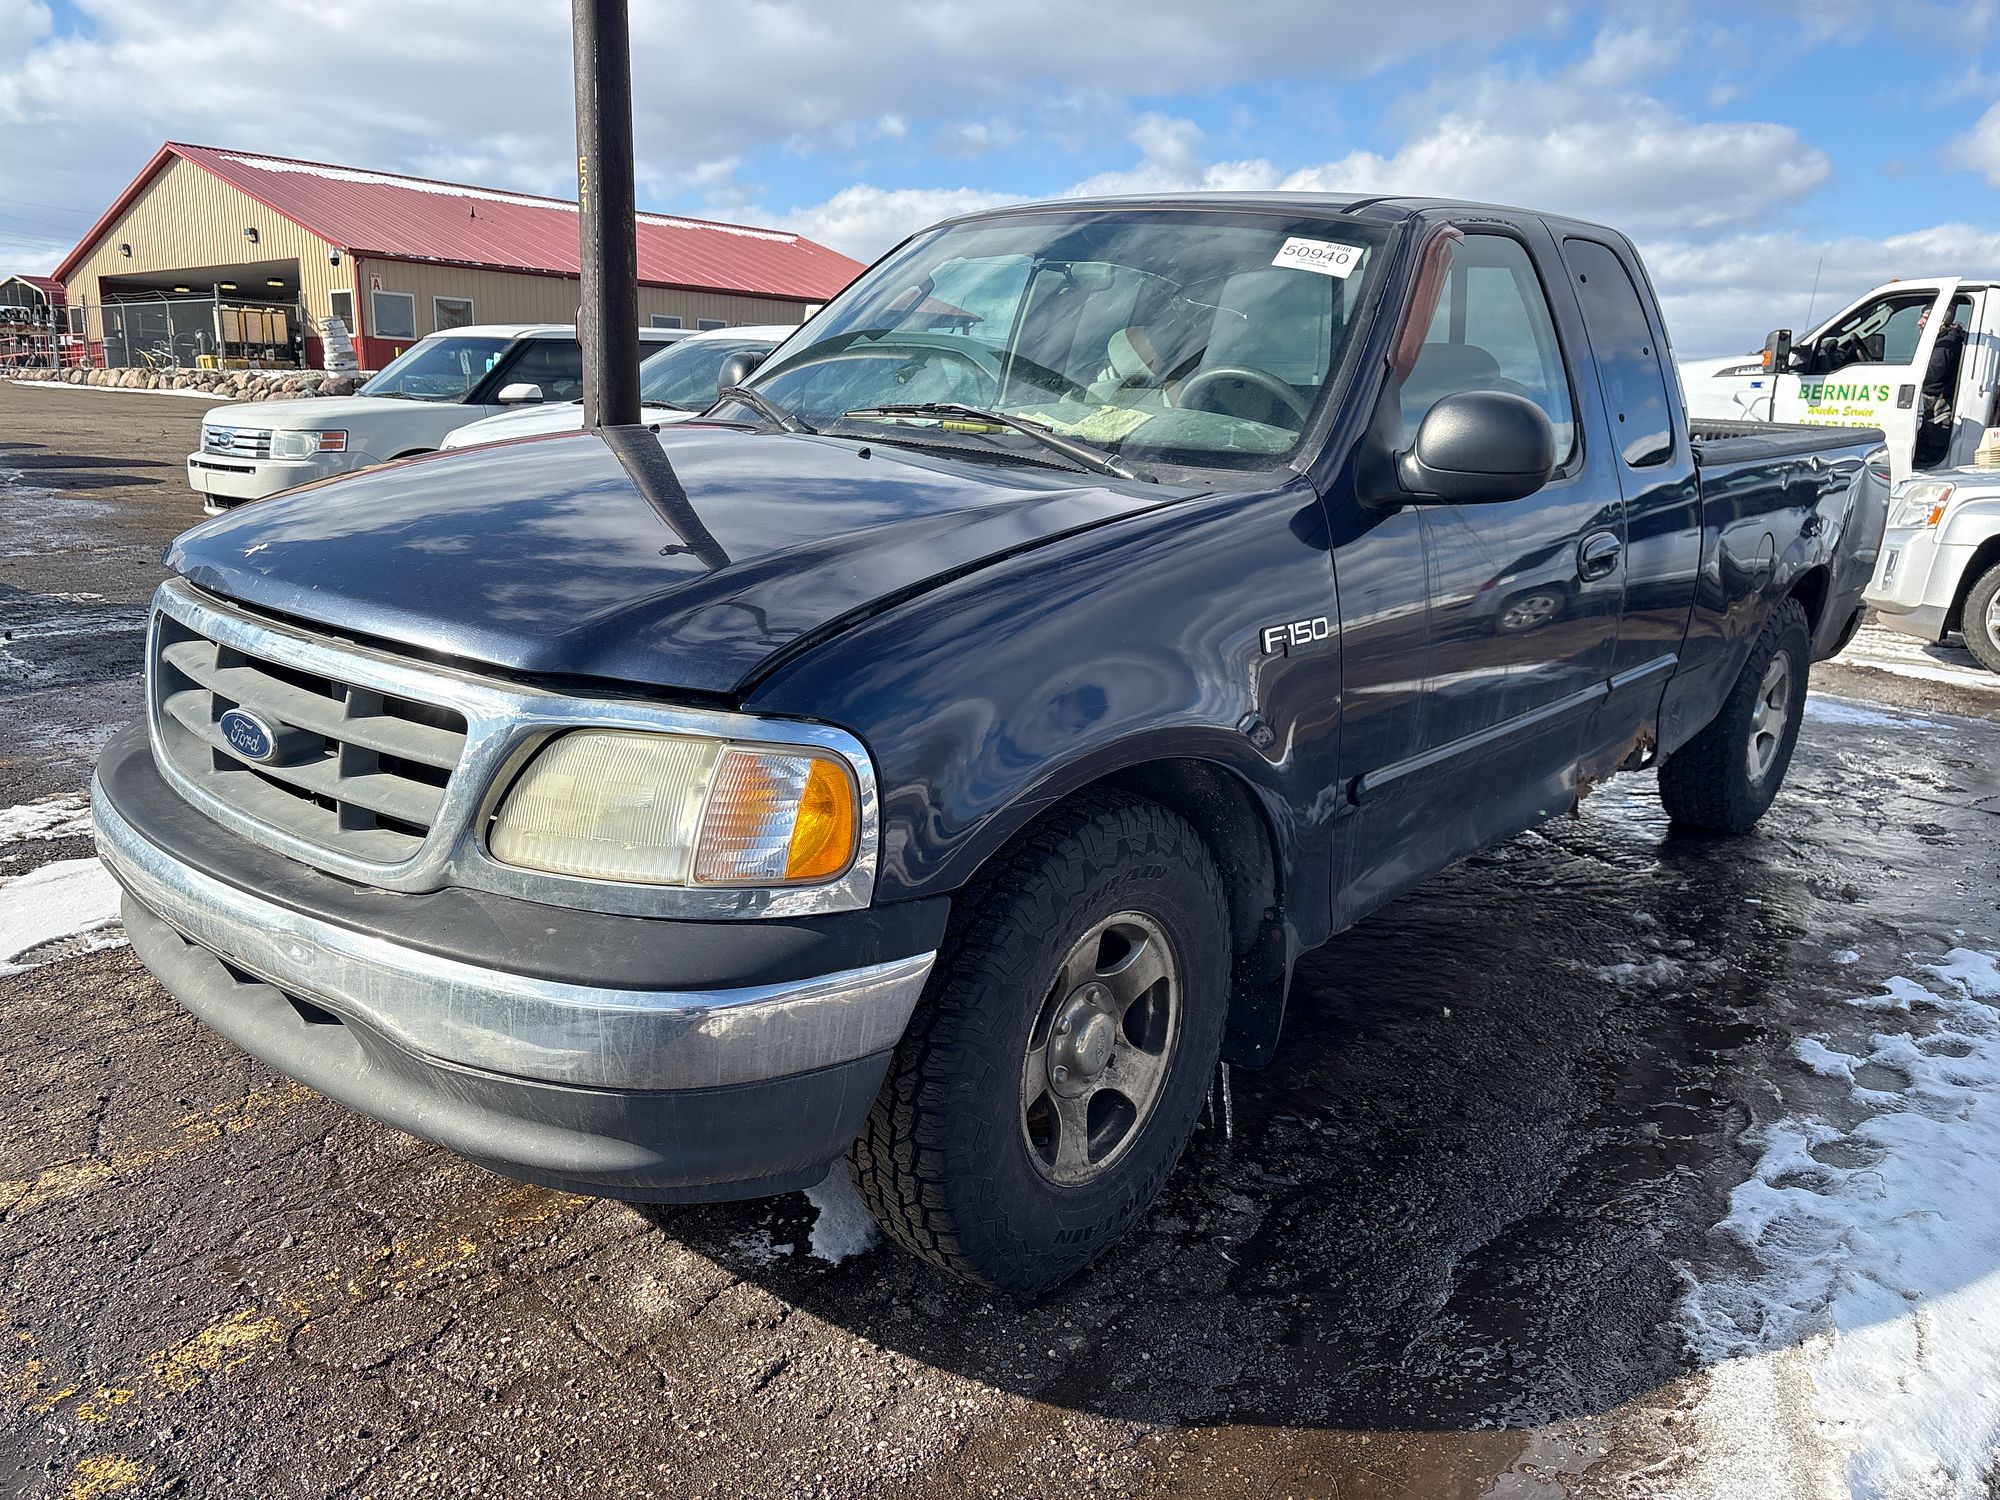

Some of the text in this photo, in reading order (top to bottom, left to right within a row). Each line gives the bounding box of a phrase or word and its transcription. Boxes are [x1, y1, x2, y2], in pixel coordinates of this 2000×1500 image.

[579, 155, 589, 214] E21
[1283, 244, 1350, 265] 50940
[373, 278, 380, 290] A
[1798, 384, 1890, 401] BERNIA'S
[1842, 405, 1874, 417] Service
[231, 718, 260, 752] Ford
